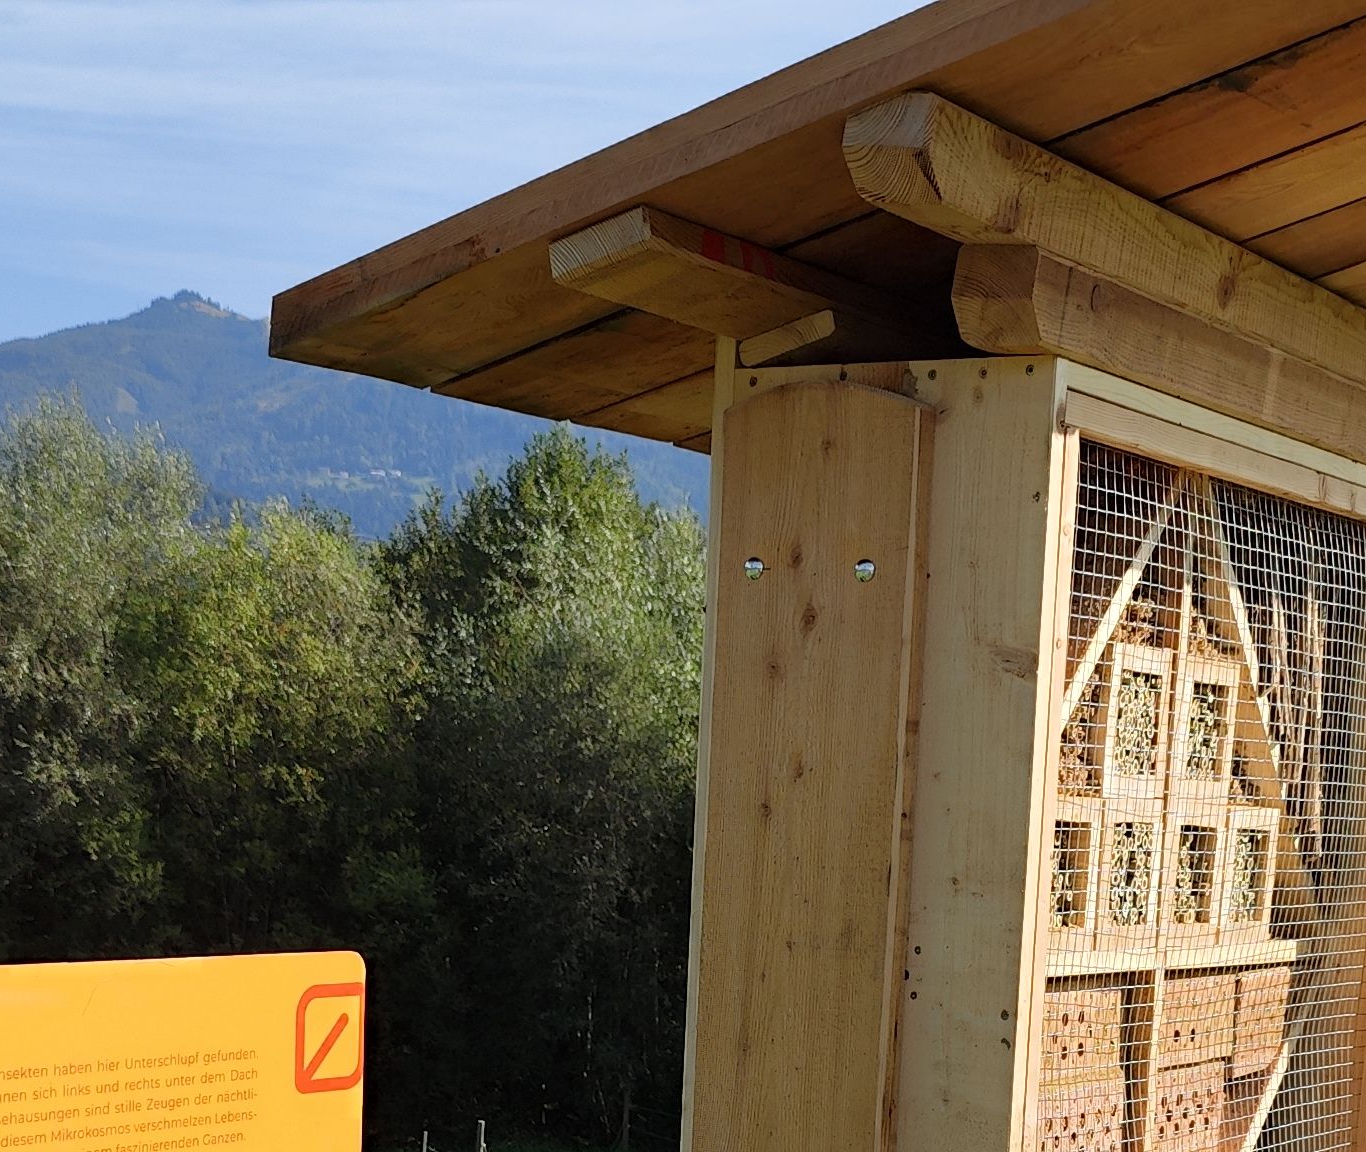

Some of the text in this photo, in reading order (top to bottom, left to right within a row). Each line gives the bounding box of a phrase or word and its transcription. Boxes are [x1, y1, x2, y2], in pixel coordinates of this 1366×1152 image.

[54, 1063, 92, 1076] haben
[97, 1061, 120, 1072] hier
[125, 1052, 200, 1070] Unterschlupf
[203, 1049, 259, 1065] gefunden.
[33, 1085, 57, 1100] sich
[63, 1084, 91, 1099] links
[96, 1081, 119, 1094] und
[125, 1077, 160, 1091] rechts
[165, 1075, 195, 1087] unter
[200, 1072, 225, 1084] dem
[230, 1068, 258, 1082] Dach
[85, 1102, 110, 1117] sind
[115, 1099, 142, 1114] stille
[146, 1096, 189, 1112] Zeugen
[194, 1094, 212, 1106] der
[216, 1088, 257, 1104] nächtli-
[1, 1132, 46, 1148] diesem
[50, 1124, 131, 1142] Mikrokosmos
[133, 1115, 211, 1133] verschmelzen
[215, 1109, 257, 1124] Lebens-
[202, 1132, 246, 1146] Ganzen.
